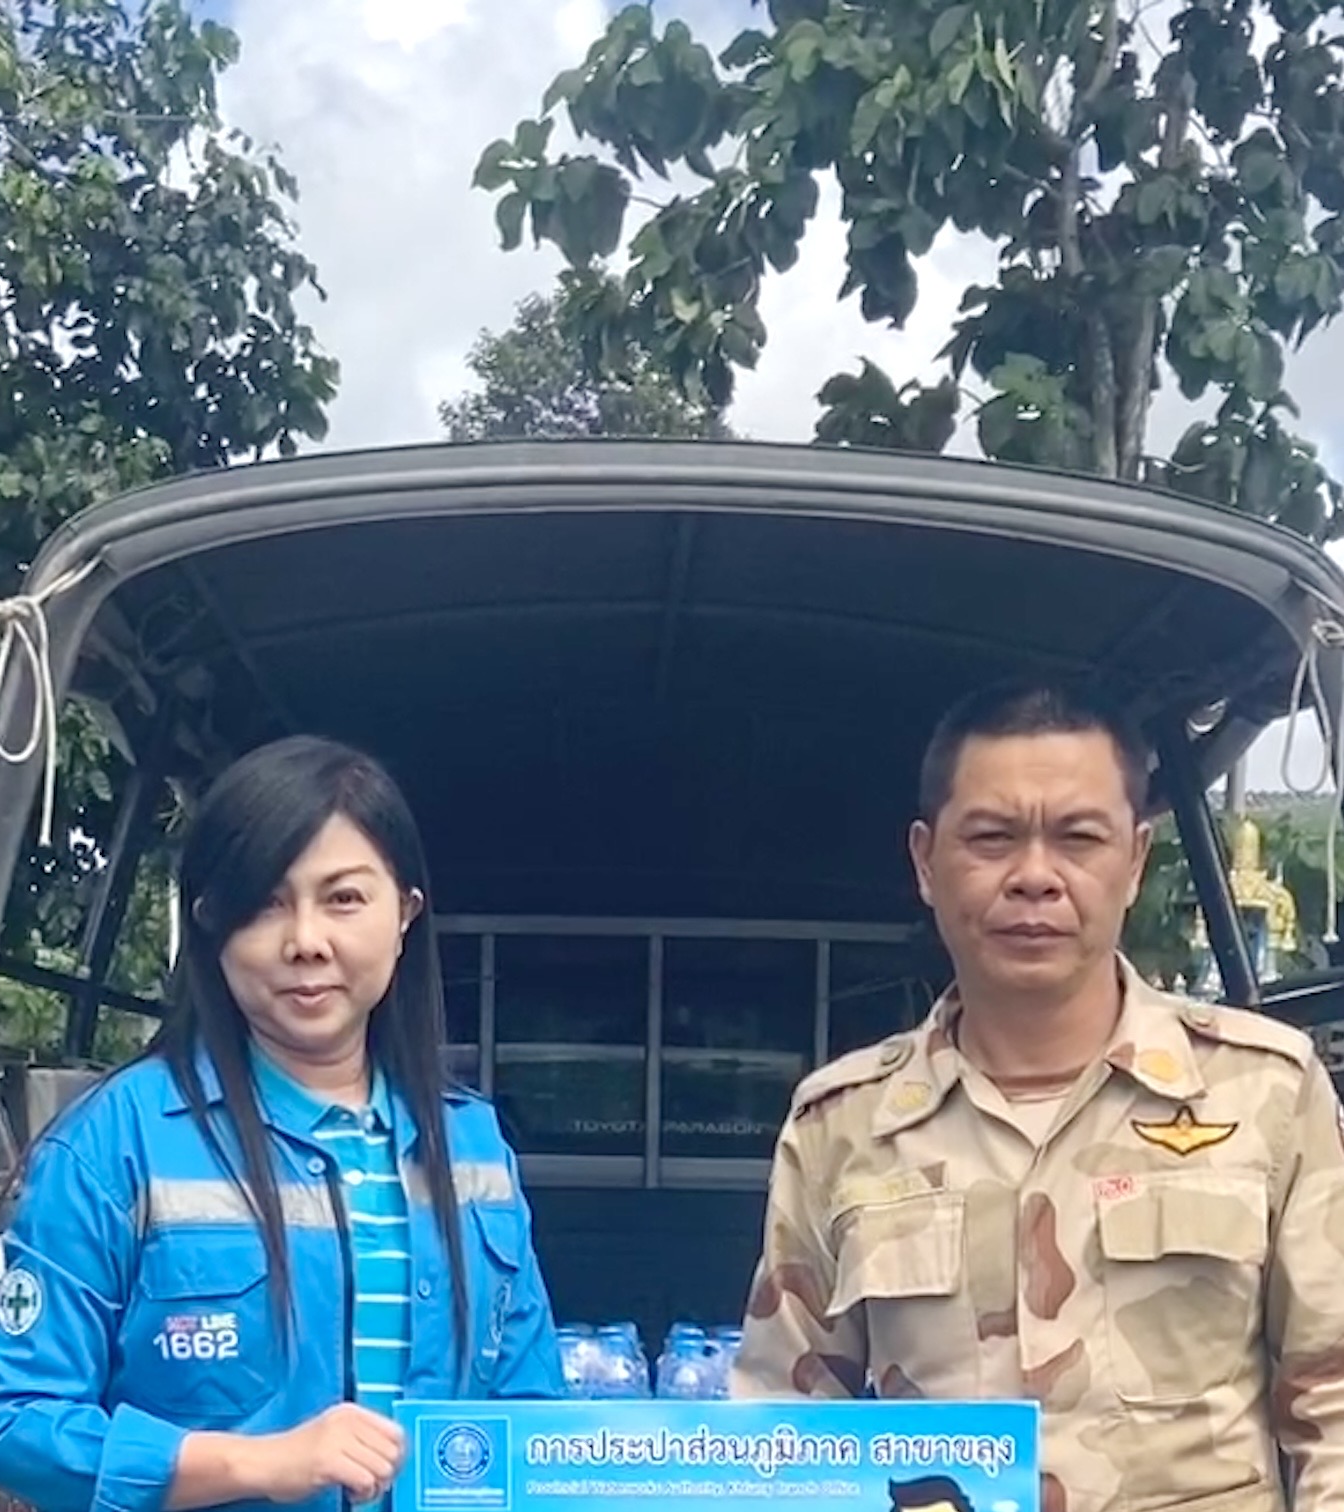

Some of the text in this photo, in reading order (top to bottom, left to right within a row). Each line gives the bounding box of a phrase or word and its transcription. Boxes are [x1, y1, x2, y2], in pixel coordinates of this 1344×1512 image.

[153, 1330, 239, 1360] 1662
[528, 1426, 1014, 1476] การประปาส่วนภูมิภาค สาขาขลุง
